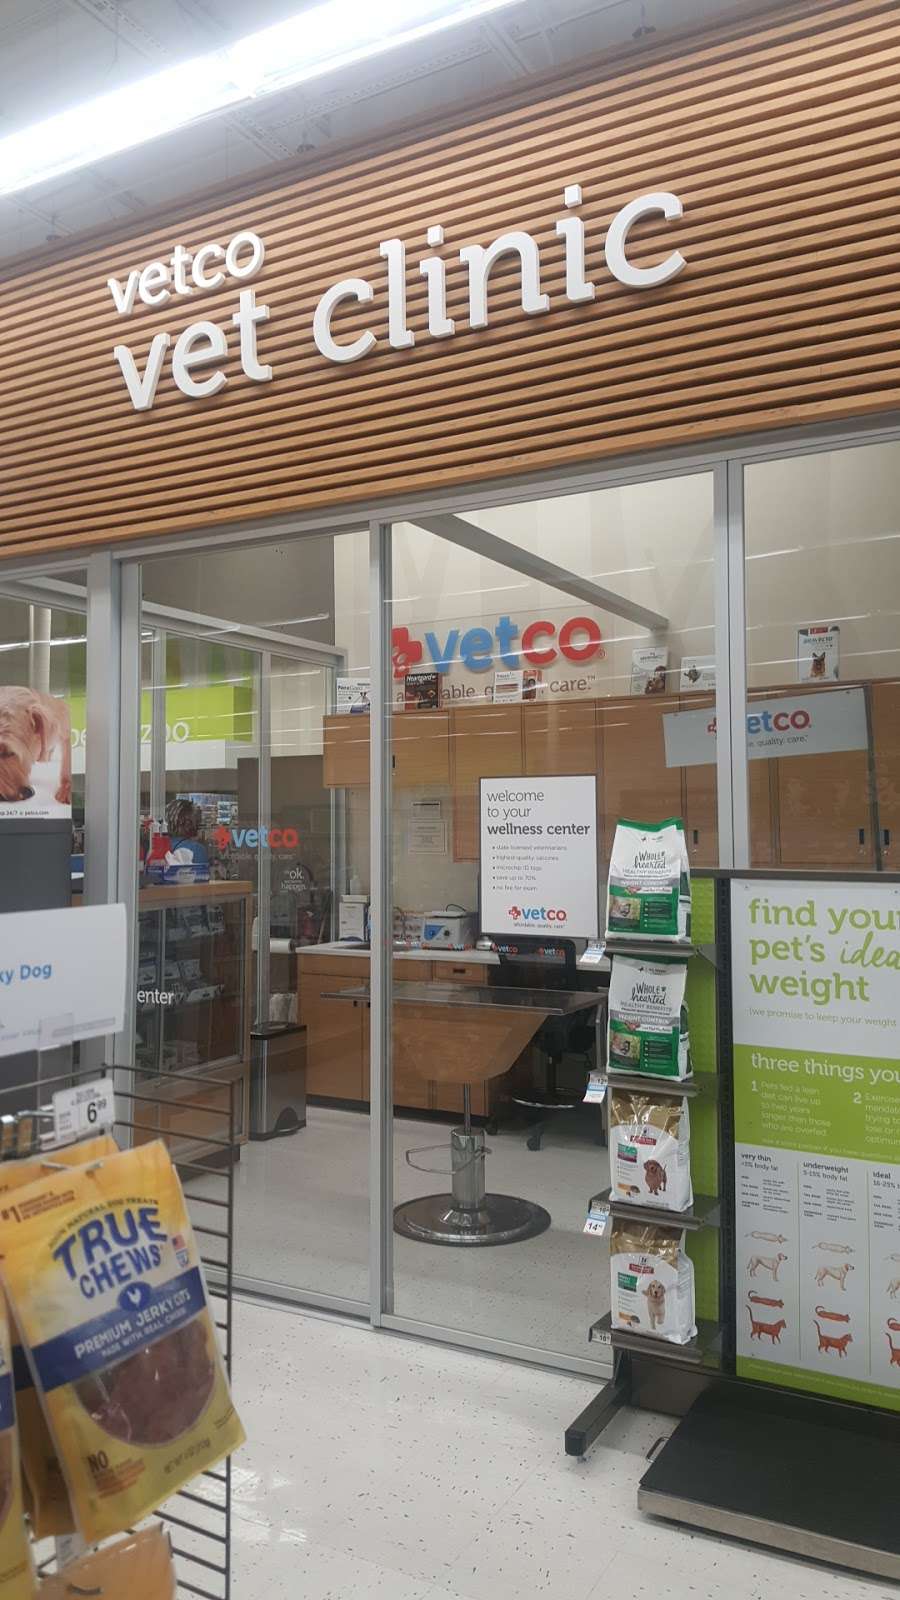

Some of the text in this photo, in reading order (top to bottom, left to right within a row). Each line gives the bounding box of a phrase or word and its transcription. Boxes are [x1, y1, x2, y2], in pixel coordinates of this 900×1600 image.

[107, 230, 266, 315] vetco
[113, 184, 688, 411] vet clinic
[425, 615, 602, 674] vetco
[141, 721, 189, 744] zo
[747, 710, 810, 734] etco
[487, 789, 545, 802] welcome
[487, 807, 532, 821] to your
[231, 825, 299, 849] vetco
[487, 823, 591, 836] wellness center
[522, 906, 567, 921] vetco
[748, 898, 817, 927] find
[748, 933, 826, 966] pet's
[20, 964, 52, 981] Dog
[748, 969, 871, 1007] weight
[840, 1015, 863, 1025] your
[751, 1052, 800, 1073] three
[804, 1058, 865, 1083] things
[752, 1080, 759, 1093] 1
[853, 1092, 862, 1104] 2
[757, 1152, 772, 1163] thin
[803, 1161, 849, 1174] underweight
[822, 1172, 838, 1182] body
[53, 1207, 168, 1280] TRUE
[79, 1243, 162, 1300] CHEWS
[73, 1319, 133, 1360] PREMIUM
[136, 1298, 176, 1328] JERKY
[87, 1449, 109, 1474] NO
